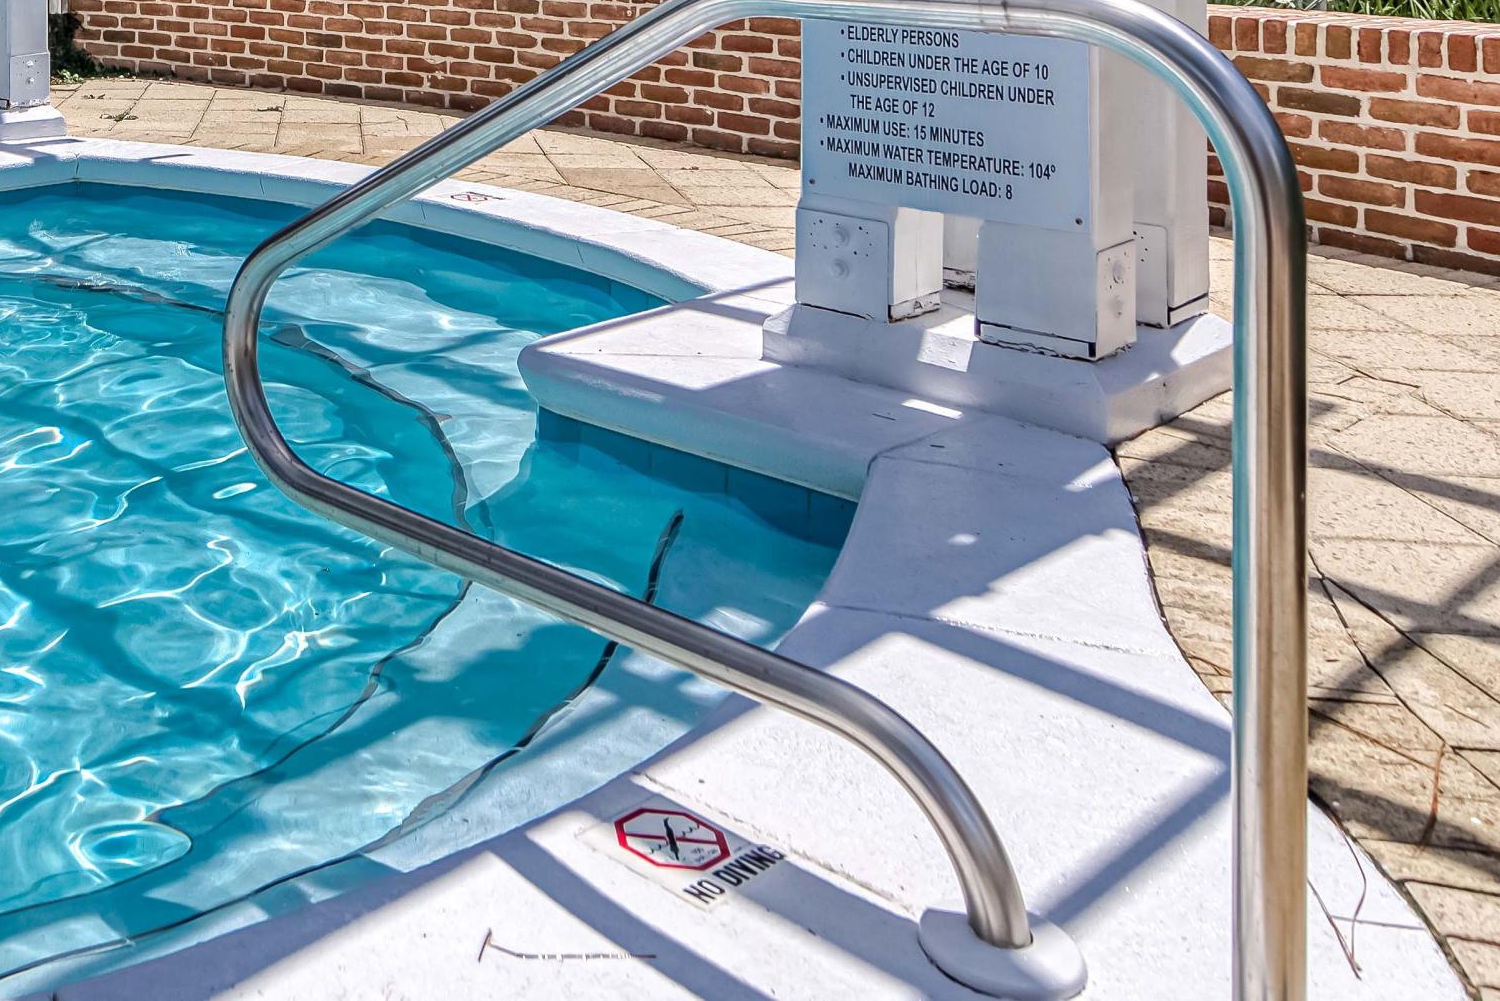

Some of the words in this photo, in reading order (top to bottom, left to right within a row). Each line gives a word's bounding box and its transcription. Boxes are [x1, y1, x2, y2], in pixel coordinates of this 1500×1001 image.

[848, 25, 898, 43] ELDERLY
[902, 30, 958, 48] PERSONS
[848, 49, 904, 67] CHILDREN
[909, 54, 950, 71] UNDER
[954, 57, 978, 74] THE
[982, 60, 1008, 76] AGE
[1013, 62, 1030, 77] OF
[1035, 64, 1048, 80] 10
[848, 71, 936, 93] UNSUPERVISED
[941, 80, 1003, 100] CHILDREN
[1009, 86, 1054, 105] UNDER
[850, 94, 871, 110] THE
[875, 97, 899, 113] AGE
[903, 100, 918, 115] OF
[923, 102, 934, 117] 12
[827, 114, 879, 134] MAXIMUM
[883, 121, 909, 138] USE:
[914, 125, 926, 140] 15
[930, 126, 984, 147] MINUTES
[827, 137, 879, 157] MAXIMUM
[883, 144, 923, 163] WATER
[927, 150, 1024, 176] TEMPERATURE:
[849, 162, 902, 184] MAXIMUM
[906, 171, 958, 192] BATHING
[963, 178, 1001, 198] LOAD:
[1006, 184, 1012, 199] 8
[683, 879, 725, 904] NO
[712, 844, 786, 887] DIVING
